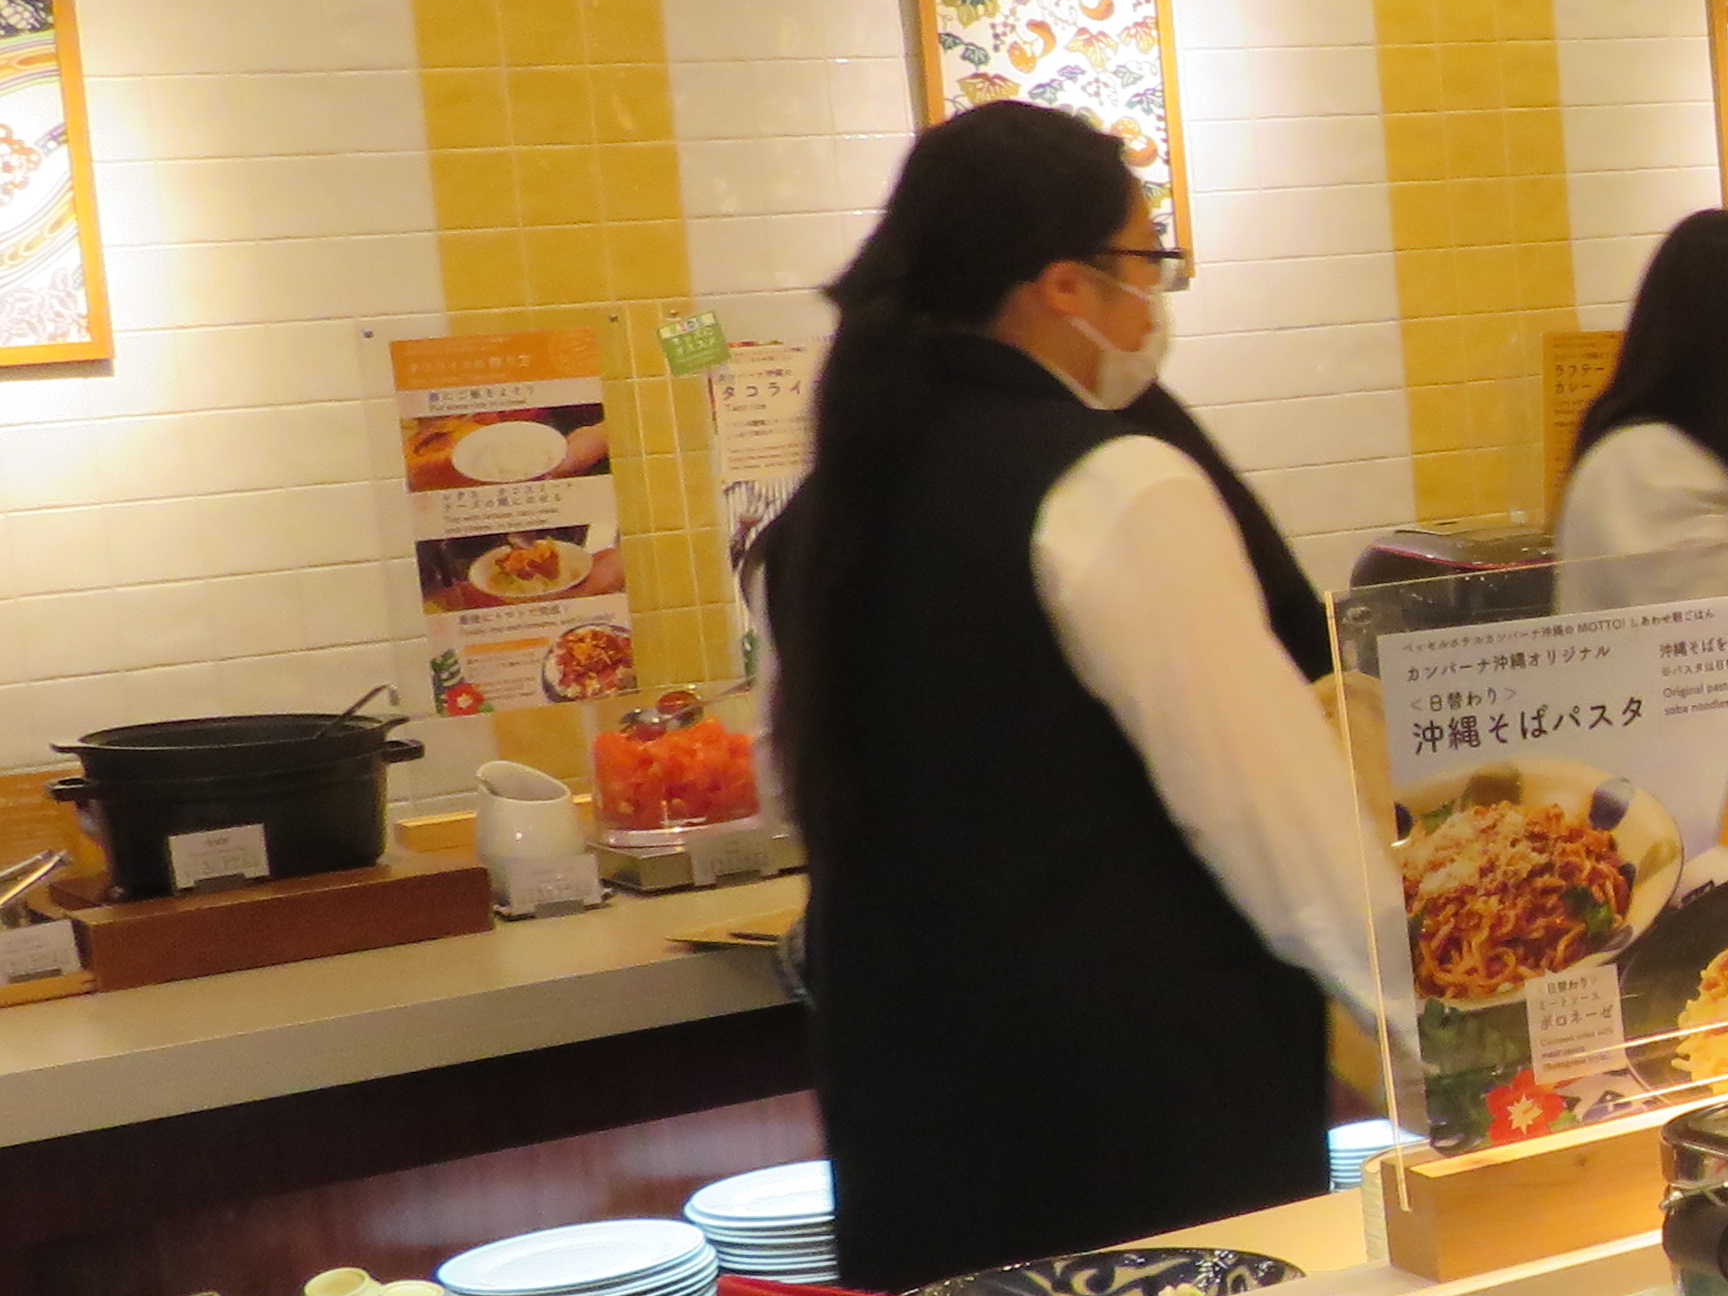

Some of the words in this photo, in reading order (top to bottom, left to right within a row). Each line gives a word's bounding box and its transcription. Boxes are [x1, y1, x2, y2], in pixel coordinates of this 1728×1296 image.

[722, 380, 802, 401] タコライ
[1577, 618, 1626, 635] MOTTO!
[1407, 645, 1611, 682] カンパーナ沖縄オリジナル
[1663, 683, 1704, 700] Original
[1413, 696, 1644, 755] 沖縄そばパスタ
[1541, 1004, 1614, 1031] ボロネーゼ
